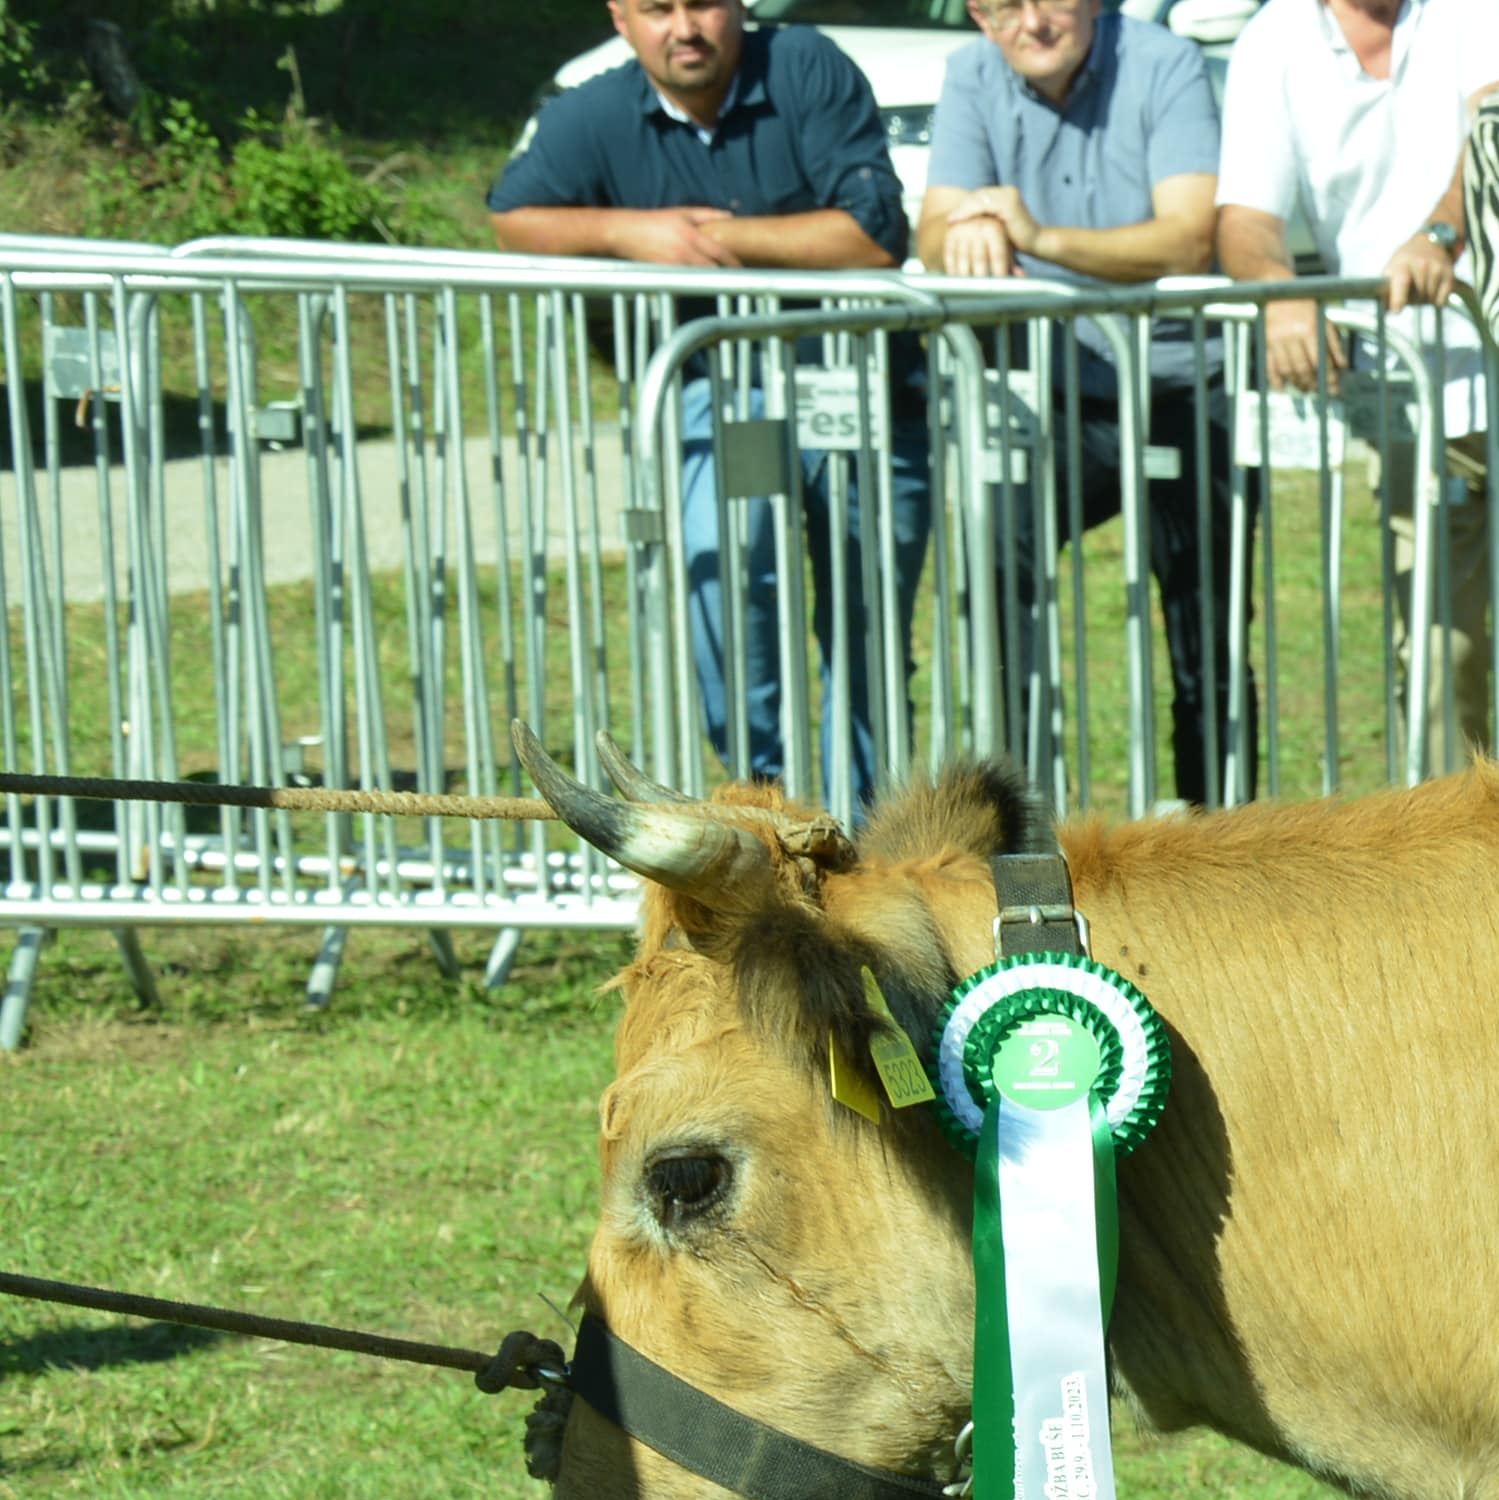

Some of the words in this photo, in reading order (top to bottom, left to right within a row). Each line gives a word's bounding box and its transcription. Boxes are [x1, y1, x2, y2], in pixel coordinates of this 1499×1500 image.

[1029, 1038, 1060, 1077] 2
[883, 1059, 927, 1098] 5323
[1066, 1377, 1085, 1438] 1.10.2023.
[1046, 1425, 1065, 1461] BUŠE
